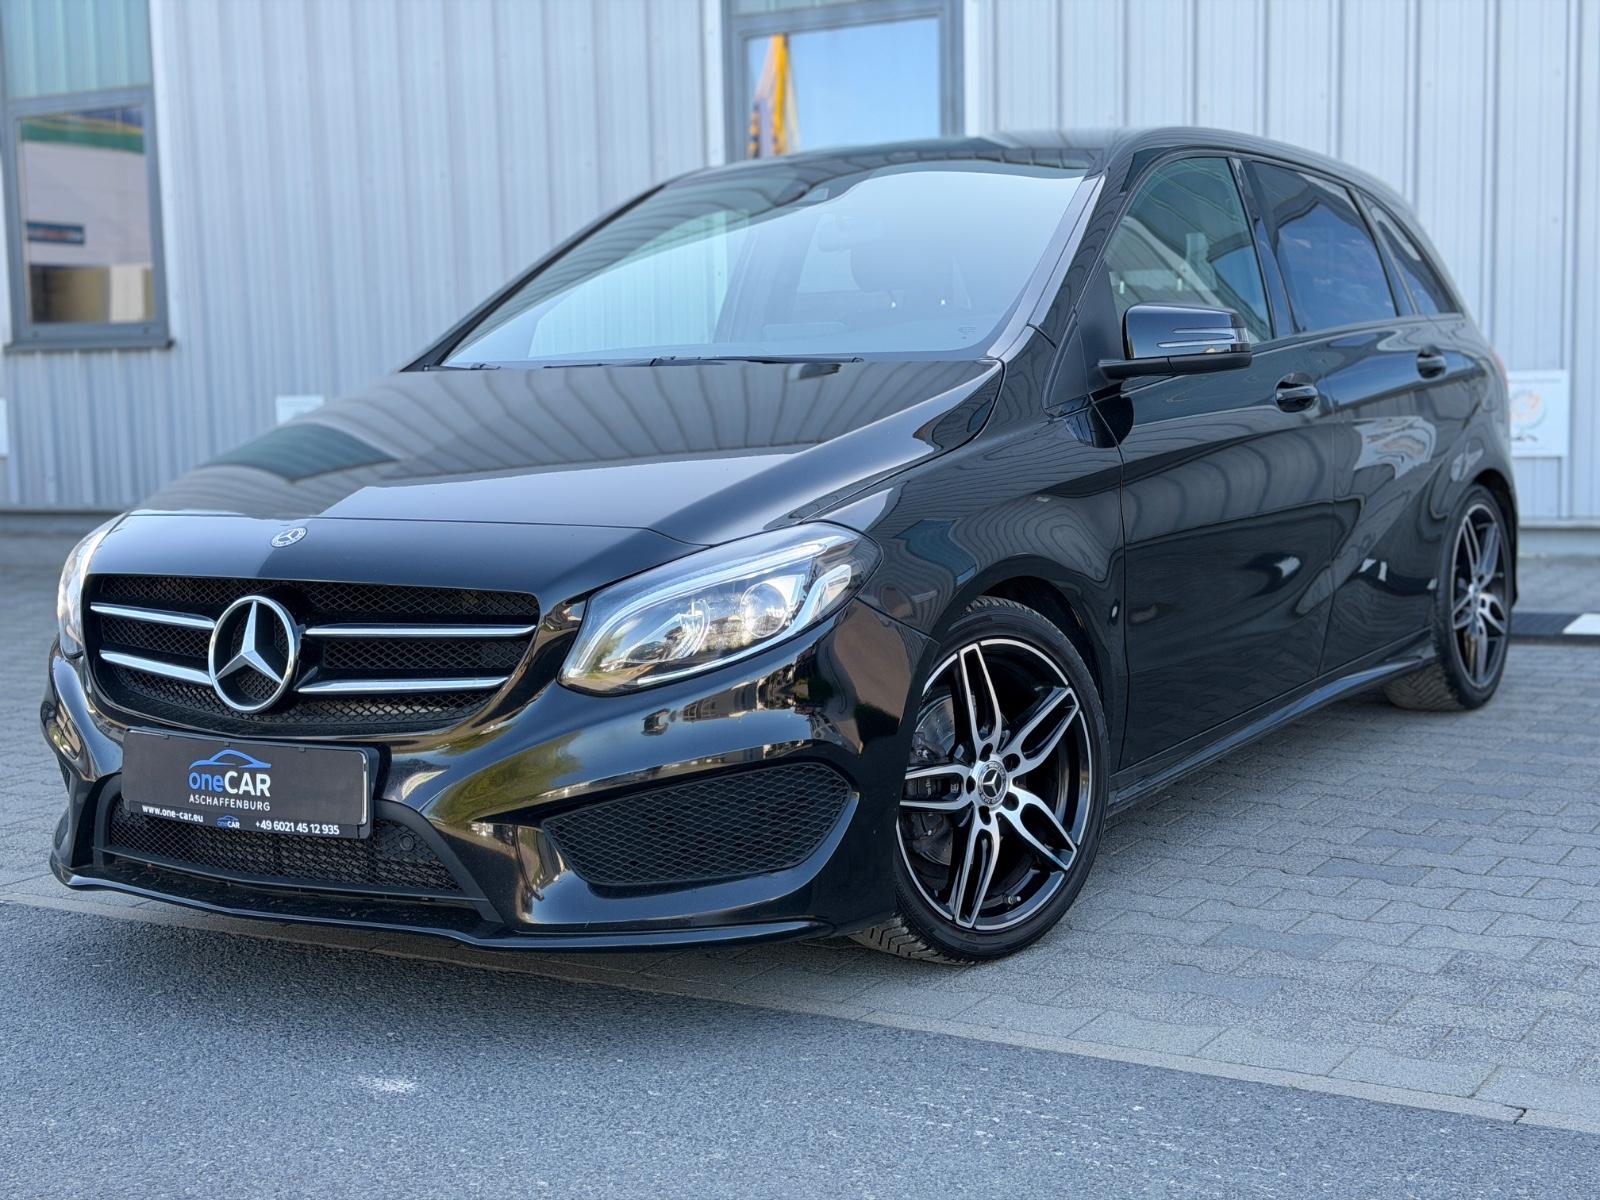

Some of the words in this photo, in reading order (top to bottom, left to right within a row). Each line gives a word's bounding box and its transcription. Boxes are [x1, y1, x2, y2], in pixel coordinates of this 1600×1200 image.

[188, 770, 271, 797] oneCAR
[188, 793, 271, 811] ASCHAFFENBURG
[141, 805, 204, 823] www.one-car.eu
[255, 820, 272, 831] +49
[273, 820, 295, 832] 6021
[296, 822, 308, 833] 45
[309, 823, 321, 834] 12
[321, 824, 340, 835] 935
